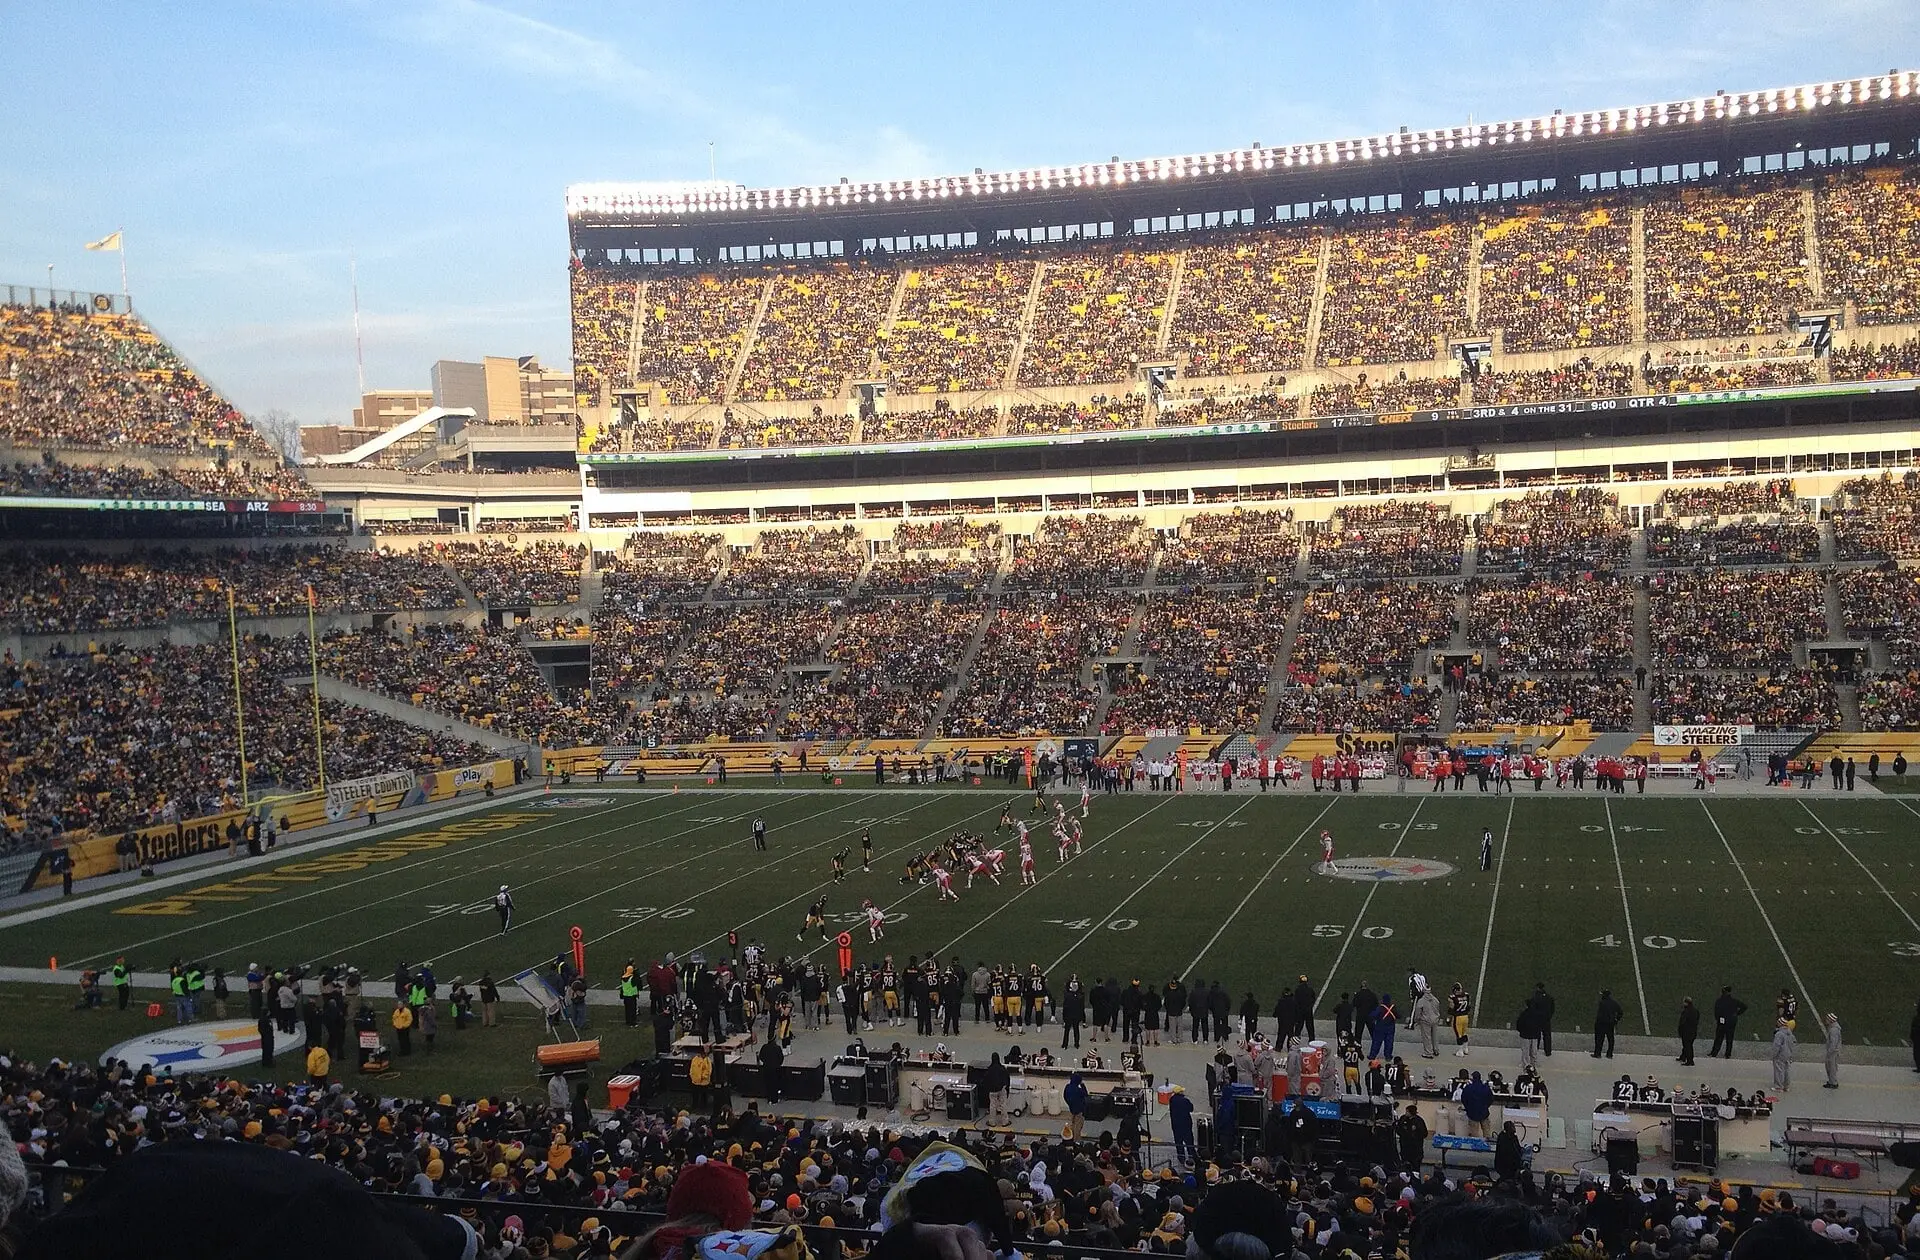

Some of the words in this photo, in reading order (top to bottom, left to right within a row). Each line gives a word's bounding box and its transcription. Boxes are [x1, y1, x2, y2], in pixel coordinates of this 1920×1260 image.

[1591, 402, 1617, 410] 9:00
[1629, 398, 1655, 408] QTR
[1658, 398, 1666, 406] 4
[1431, 412, 1439, 421] 9
[1473, 409, 1496, 419] 3RD
[1498, 408, 1506, 416] &
[1511, 407, 1519, 415] 4
[1538, 405, 1556, 413] THE
[1558, 404, 1573, 413] 31
[1331, 418, 1344, 428] 17
[1378, 413, 1413, 424] CHIEFS
[1282, 420, 1319, 430] Steelers
[205, 502, 226, 511] SEA
[246, 502, 269, 511] ARZ
[1682, 726, 1738, 735] AMAZING
[1682, 735, 1738, 745] STEELERS
[462, 769, 481, 784] Play
[331, 784, 374, 803] STEELER
[375, 773, 413, 795] COUNTRY
[135, 822, 220, 864] teelers
[111, 813, 558, 916] PITTSBURGH
[1312, 924, 1394, 939] 50
[883, 975, 895, 987] 98
[927, 975, 938, 986] 85
[1009, 980, 1019, 991] 76
[1031, 980, 1042, 991] 46
[1345, 1051, 1359, 1063] 20
[1388, 1067, 1398, 1081] 91
[1618, 1083, 1633, 1097] 22
[1316, 1108, 1338, 1116] Surface
